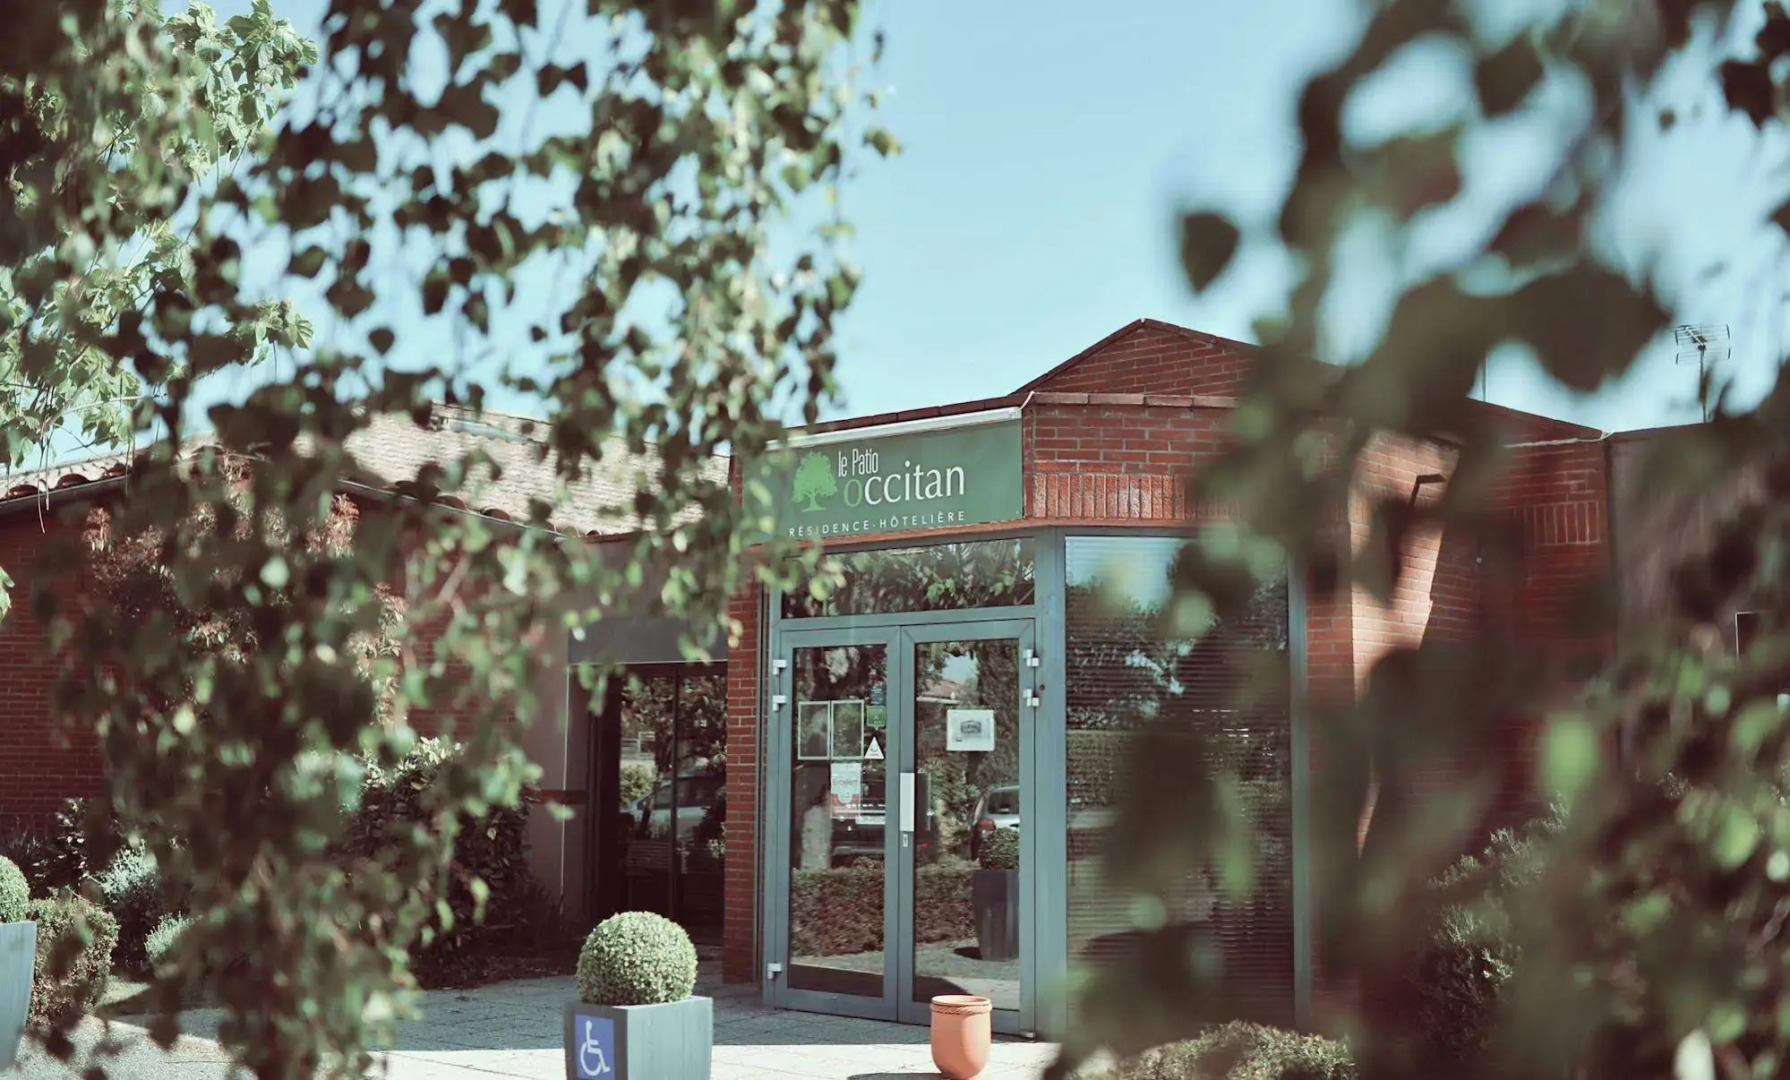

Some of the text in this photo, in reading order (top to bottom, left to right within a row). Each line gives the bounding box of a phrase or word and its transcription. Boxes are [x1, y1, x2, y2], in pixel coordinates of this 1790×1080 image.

[838, 448, 879, 477] le Patio
[843, 460, 965, 507] occitan
[879, 511, 965, 529] HÔTELIÈRE
